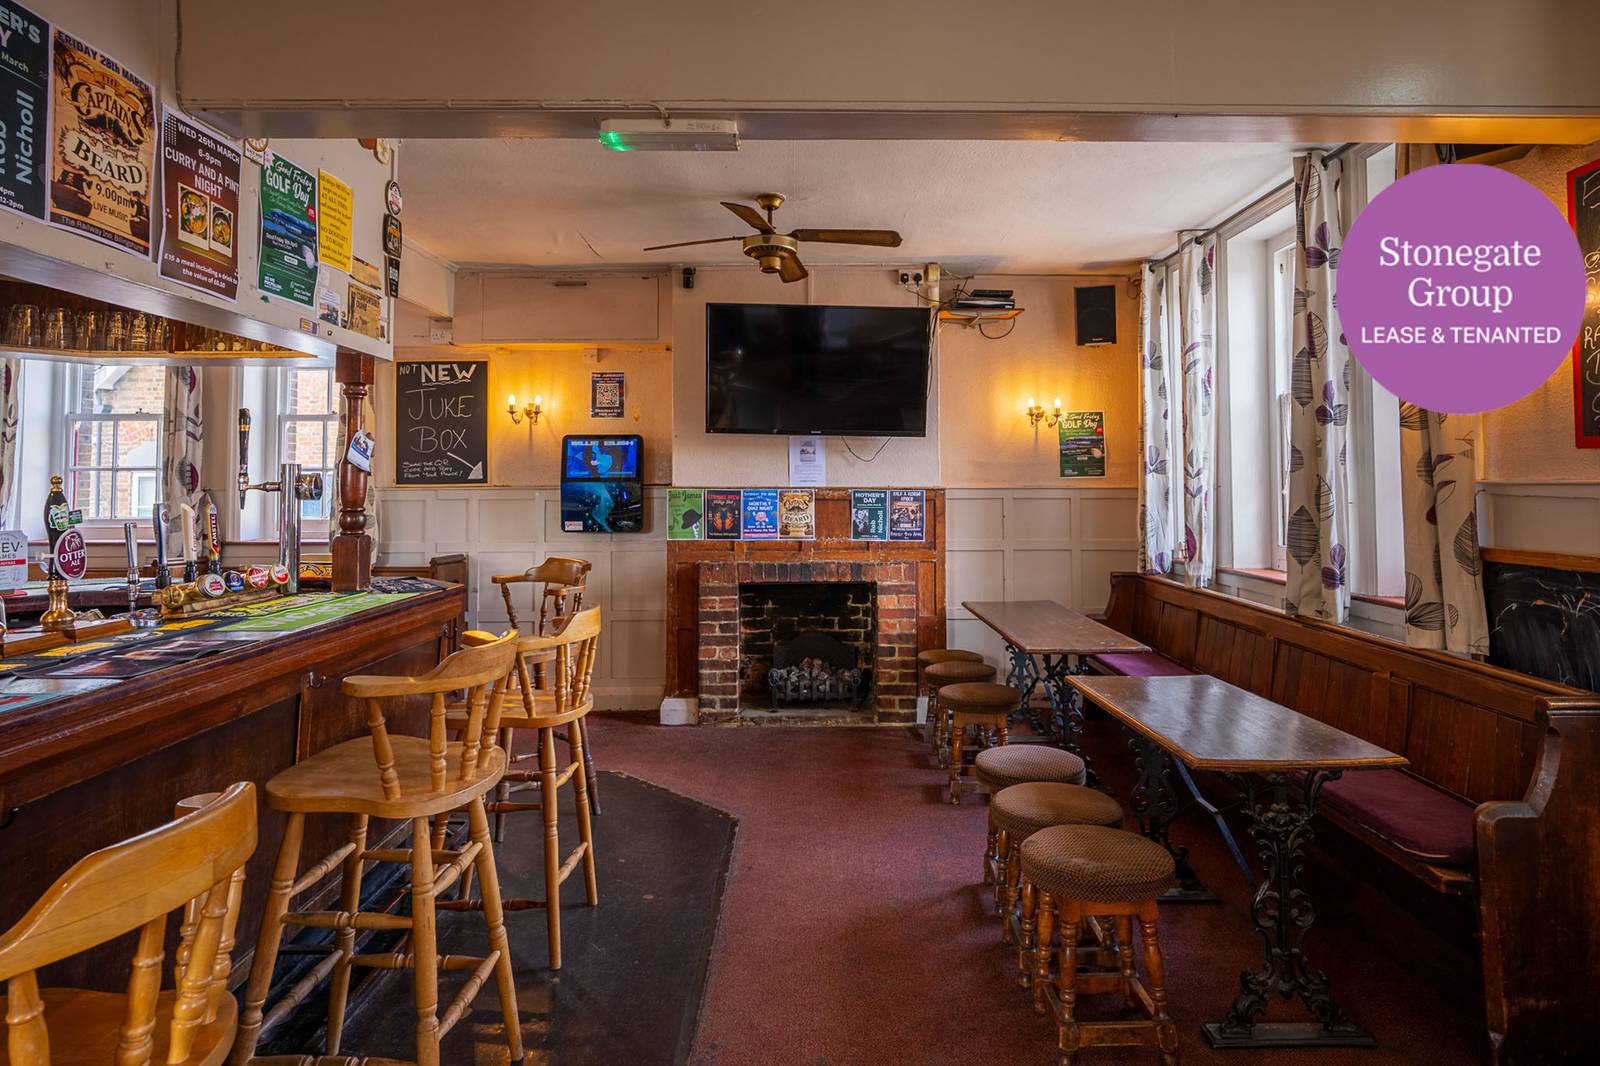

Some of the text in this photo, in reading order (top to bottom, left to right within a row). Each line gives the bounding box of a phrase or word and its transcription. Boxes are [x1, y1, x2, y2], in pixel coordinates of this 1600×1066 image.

[1, 51, 29, 73] March
[58, 30, 97, 60] FRIDAY
[100, 54, 120, 74] 28th
[16, 89, 34, 185] Nicholl
[177, 122, 197, 139] WED
[217, 144, 240, 165] MARCH
[72, 137, 143, 184] BEARD
[198, 148, 222, 167] 6-9pm
[165, 147, 240, 194] CURRY AND A PINT
[275, 161, 313, 192] Good Friday
[96, 183, 133, 208] 9.00pm
[194, 174, 223, 199] NIGHT
[266, 168, 291, 194] GOLF
[292, 182, 310, 208] Day
[62, 216, 75, 226] The
[93, 201, 129, 222] LIVE MUSIC
[399, 364, 477, 383] NOT NEW
[405, 387, 475, 420] JUKE
[1062, 420, 1098, 430] GOLF Day
[409, 425, 468, 453] BOX
[784, 514, 809, 523] BEARD
[60, 549, 86, 563] OTTER
